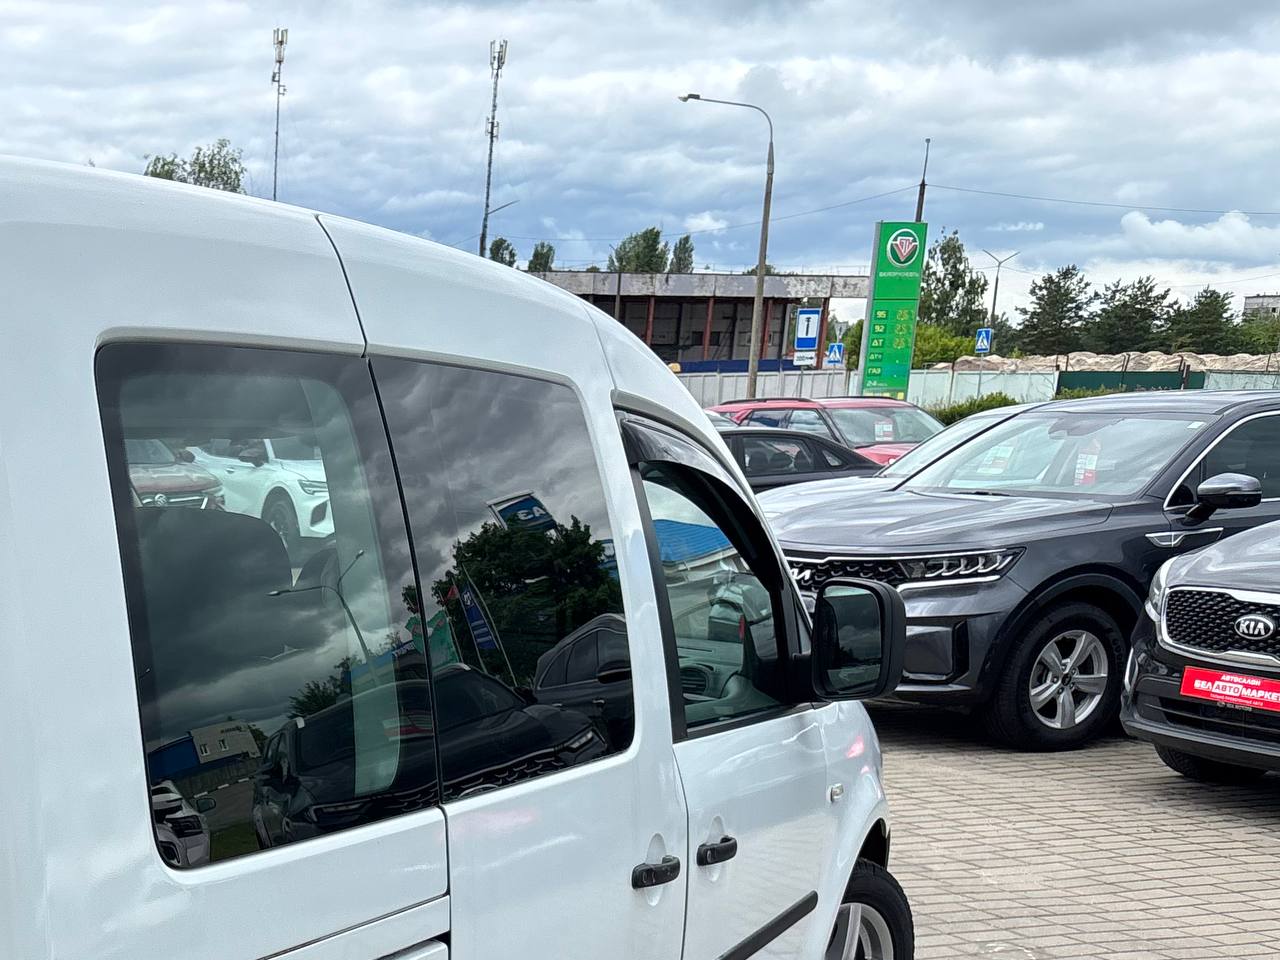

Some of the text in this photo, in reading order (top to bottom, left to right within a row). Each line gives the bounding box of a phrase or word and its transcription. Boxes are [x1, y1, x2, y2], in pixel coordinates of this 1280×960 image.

[1239, 620, 1266, 635] KIA
[1221, 674, 1261, 686] АВТОСАЛОН
[1241, 687, 1280, 702] МАРКЕ
